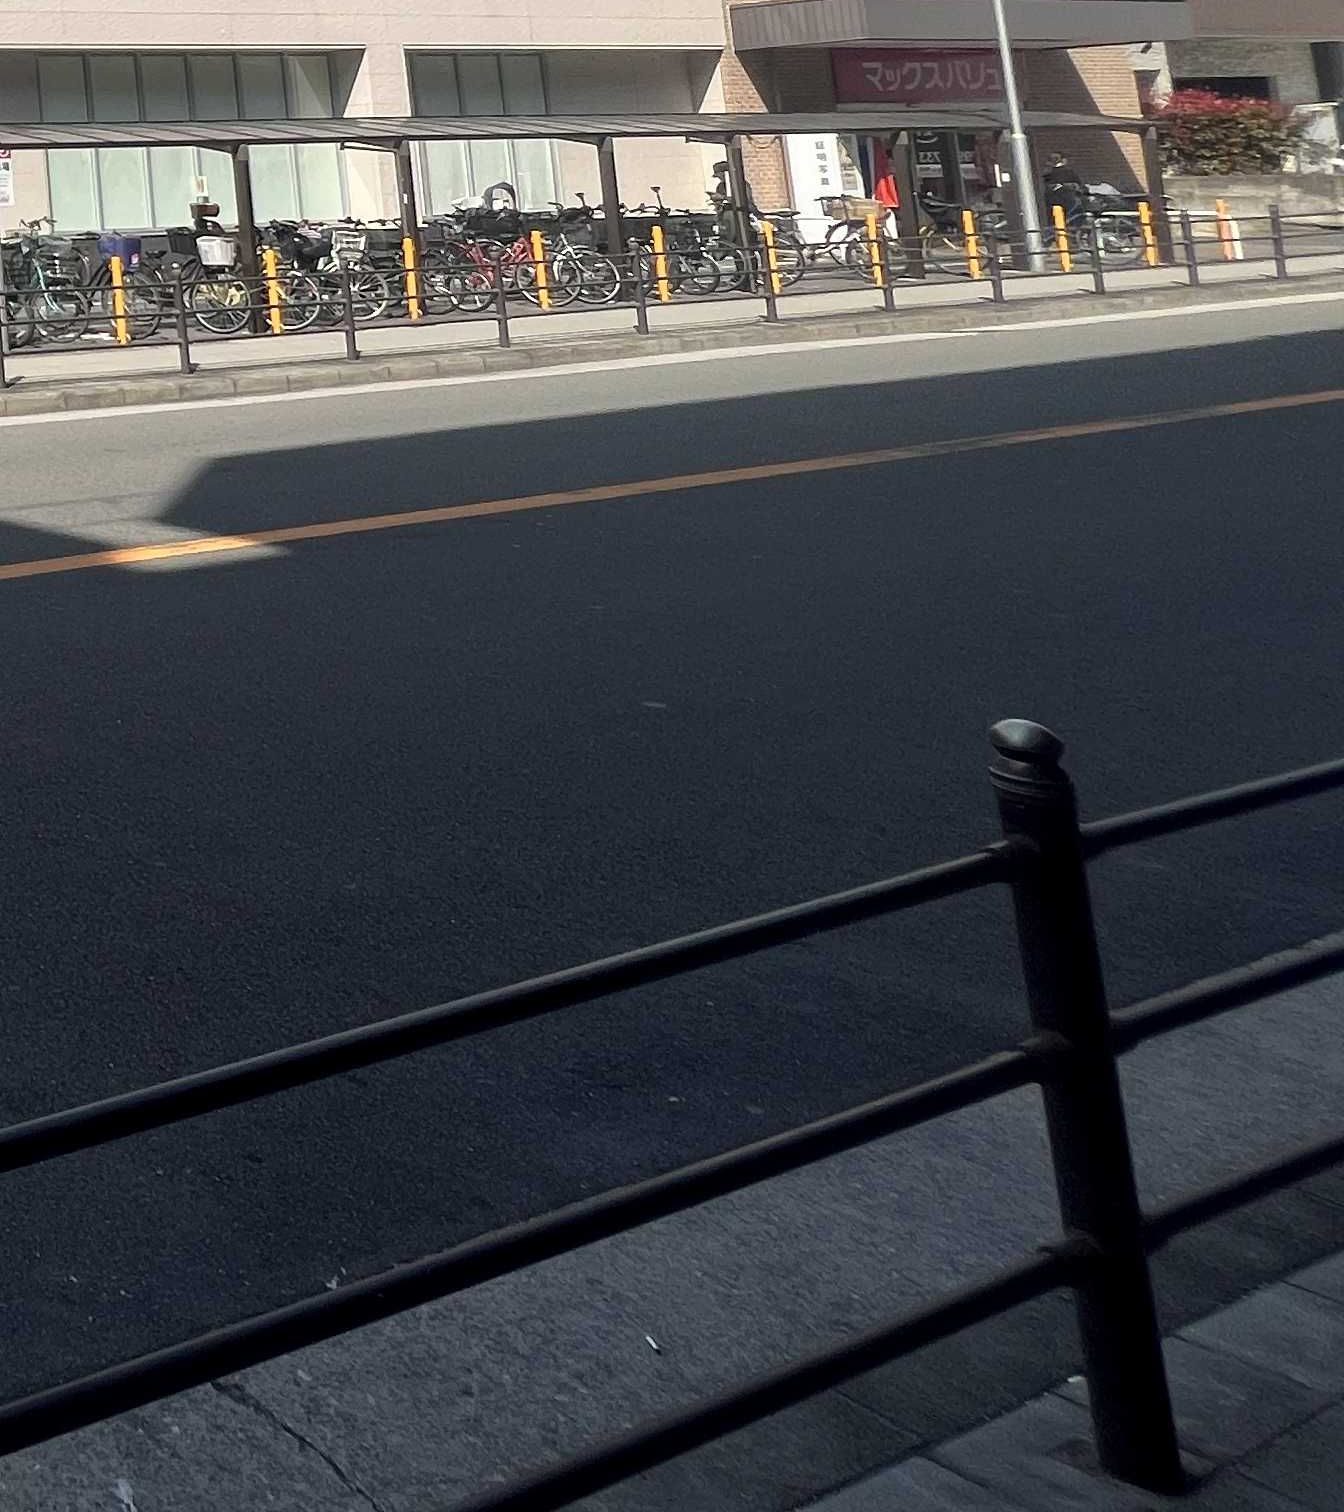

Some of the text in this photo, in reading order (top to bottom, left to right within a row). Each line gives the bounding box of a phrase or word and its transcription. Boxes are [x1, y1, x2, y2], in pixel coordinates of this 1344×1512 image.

[861, 60, 1003, 92] マックスバリュ
